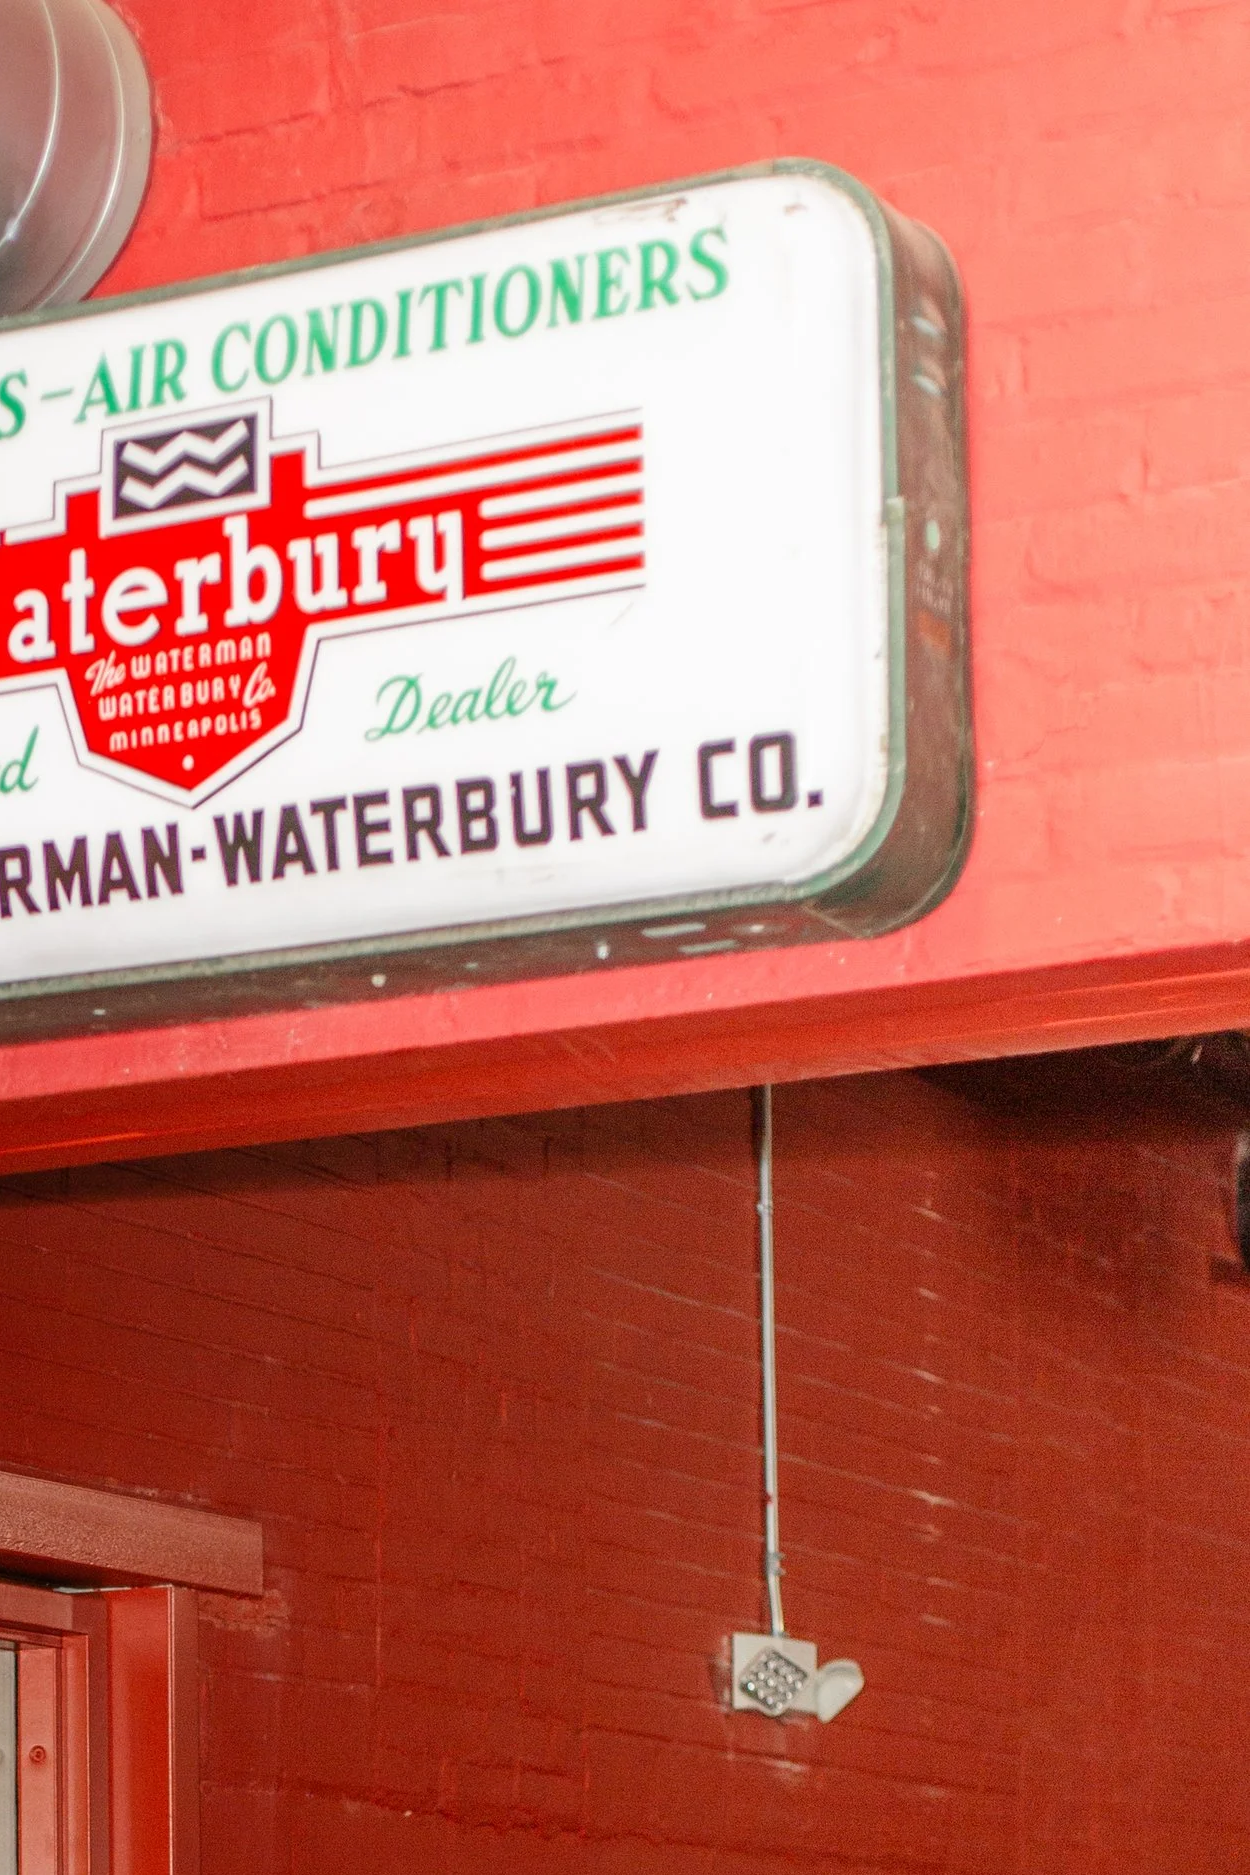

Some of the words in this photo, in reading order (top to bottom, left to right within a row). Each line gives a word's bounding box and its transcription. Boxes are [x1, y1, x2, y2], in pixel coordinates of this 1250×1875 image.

[209, 226, 729, 395] CONDITIONERS
[84, 649, 126, 697] The
[130, 631, 272, 680] WATERMAN
[97, 673, 242, 722] WATERBURY
[364, 655, 577, 742] Dealer
[108, 707, 262, 753] MINNEAPOLIS
[696, 730, 824, 823] CO.
